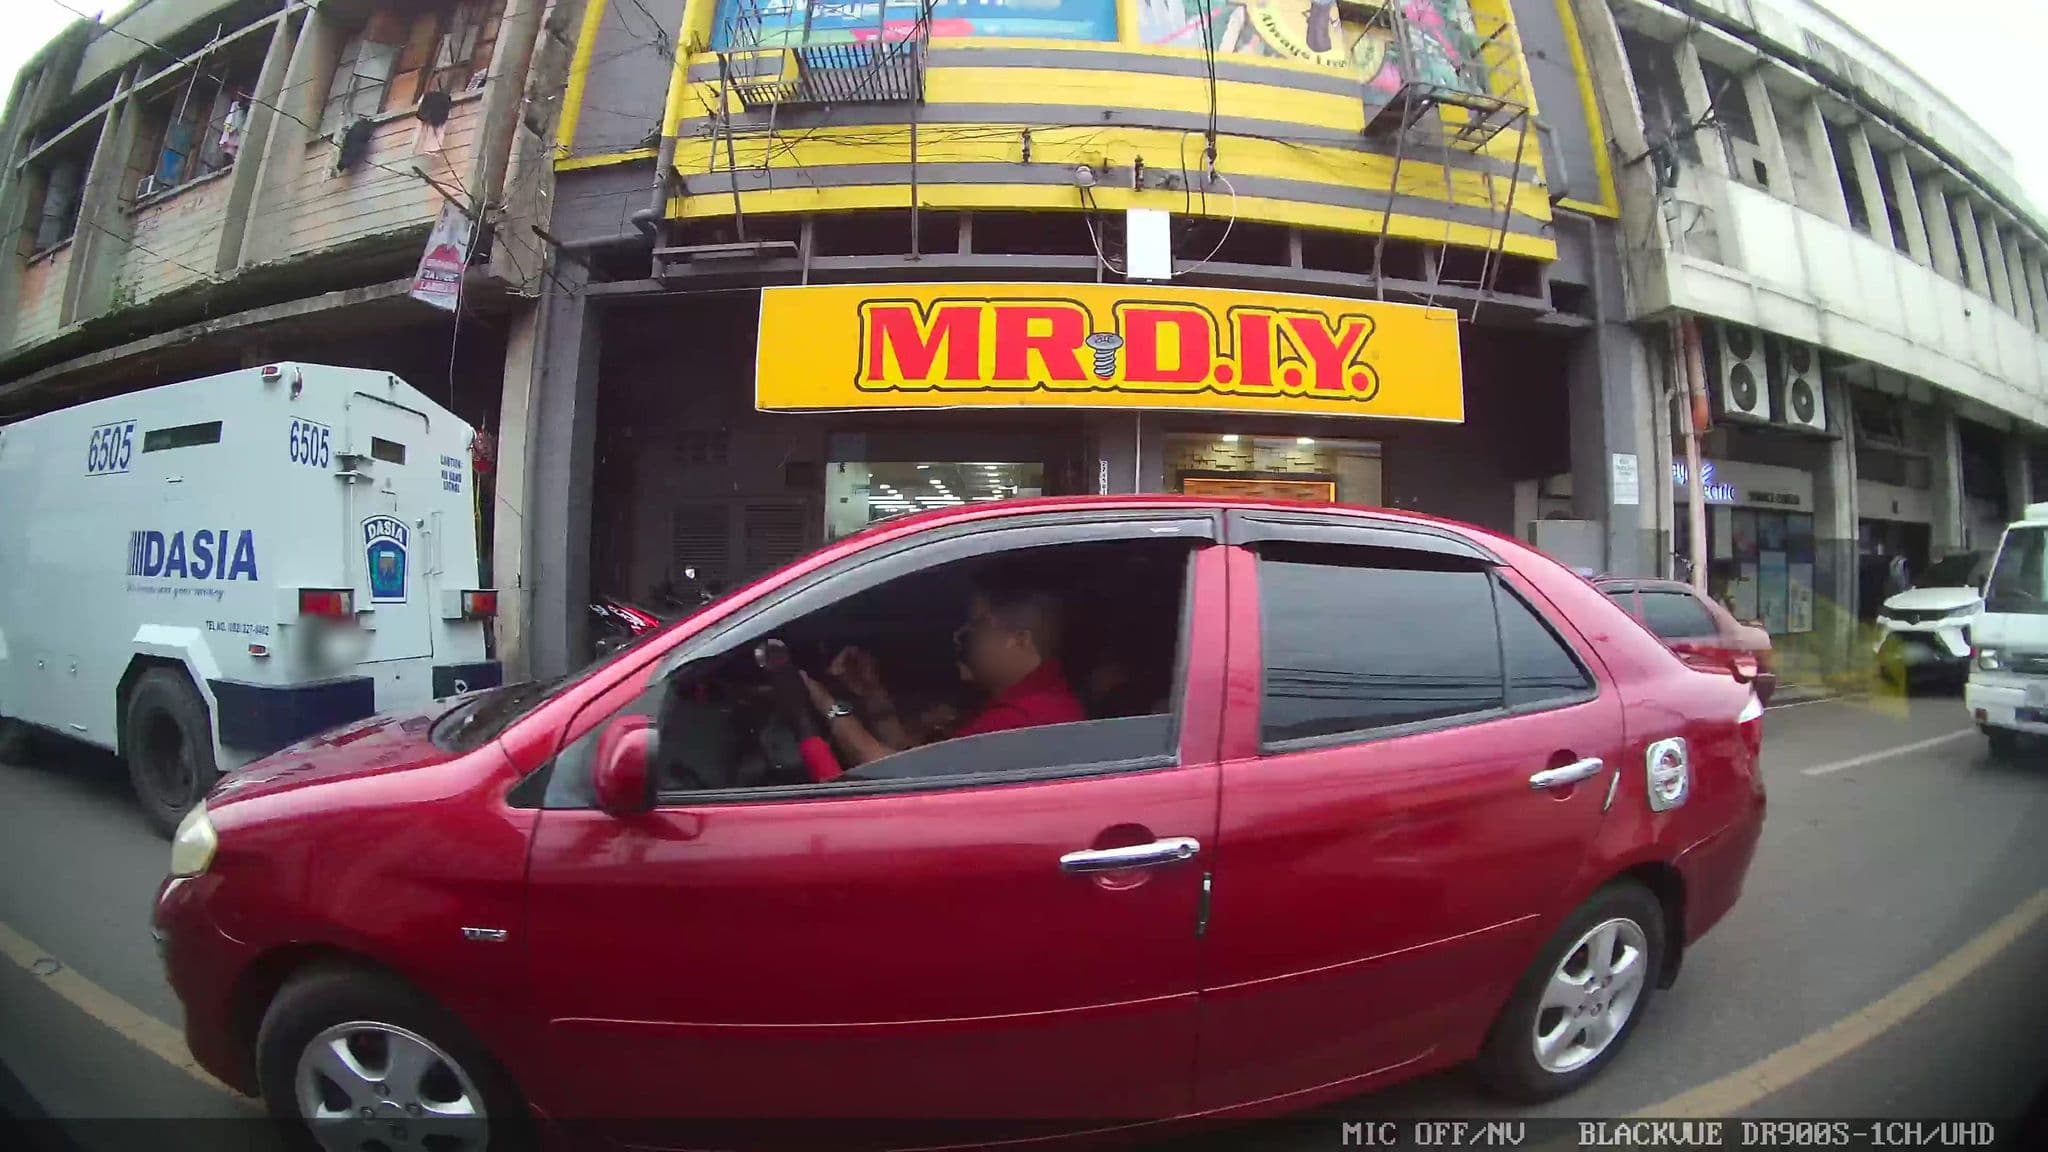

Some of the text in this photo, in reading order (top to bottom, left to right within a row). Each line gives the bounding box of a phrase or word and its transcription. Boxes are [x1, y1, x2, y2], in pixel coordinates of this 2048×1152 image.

[88, 424, 134, 473] 6505
[289, 420, 329, 468] 6505
[143, 529, 258, 581] DASIA
[367, 520, 403, 543] DASIA
